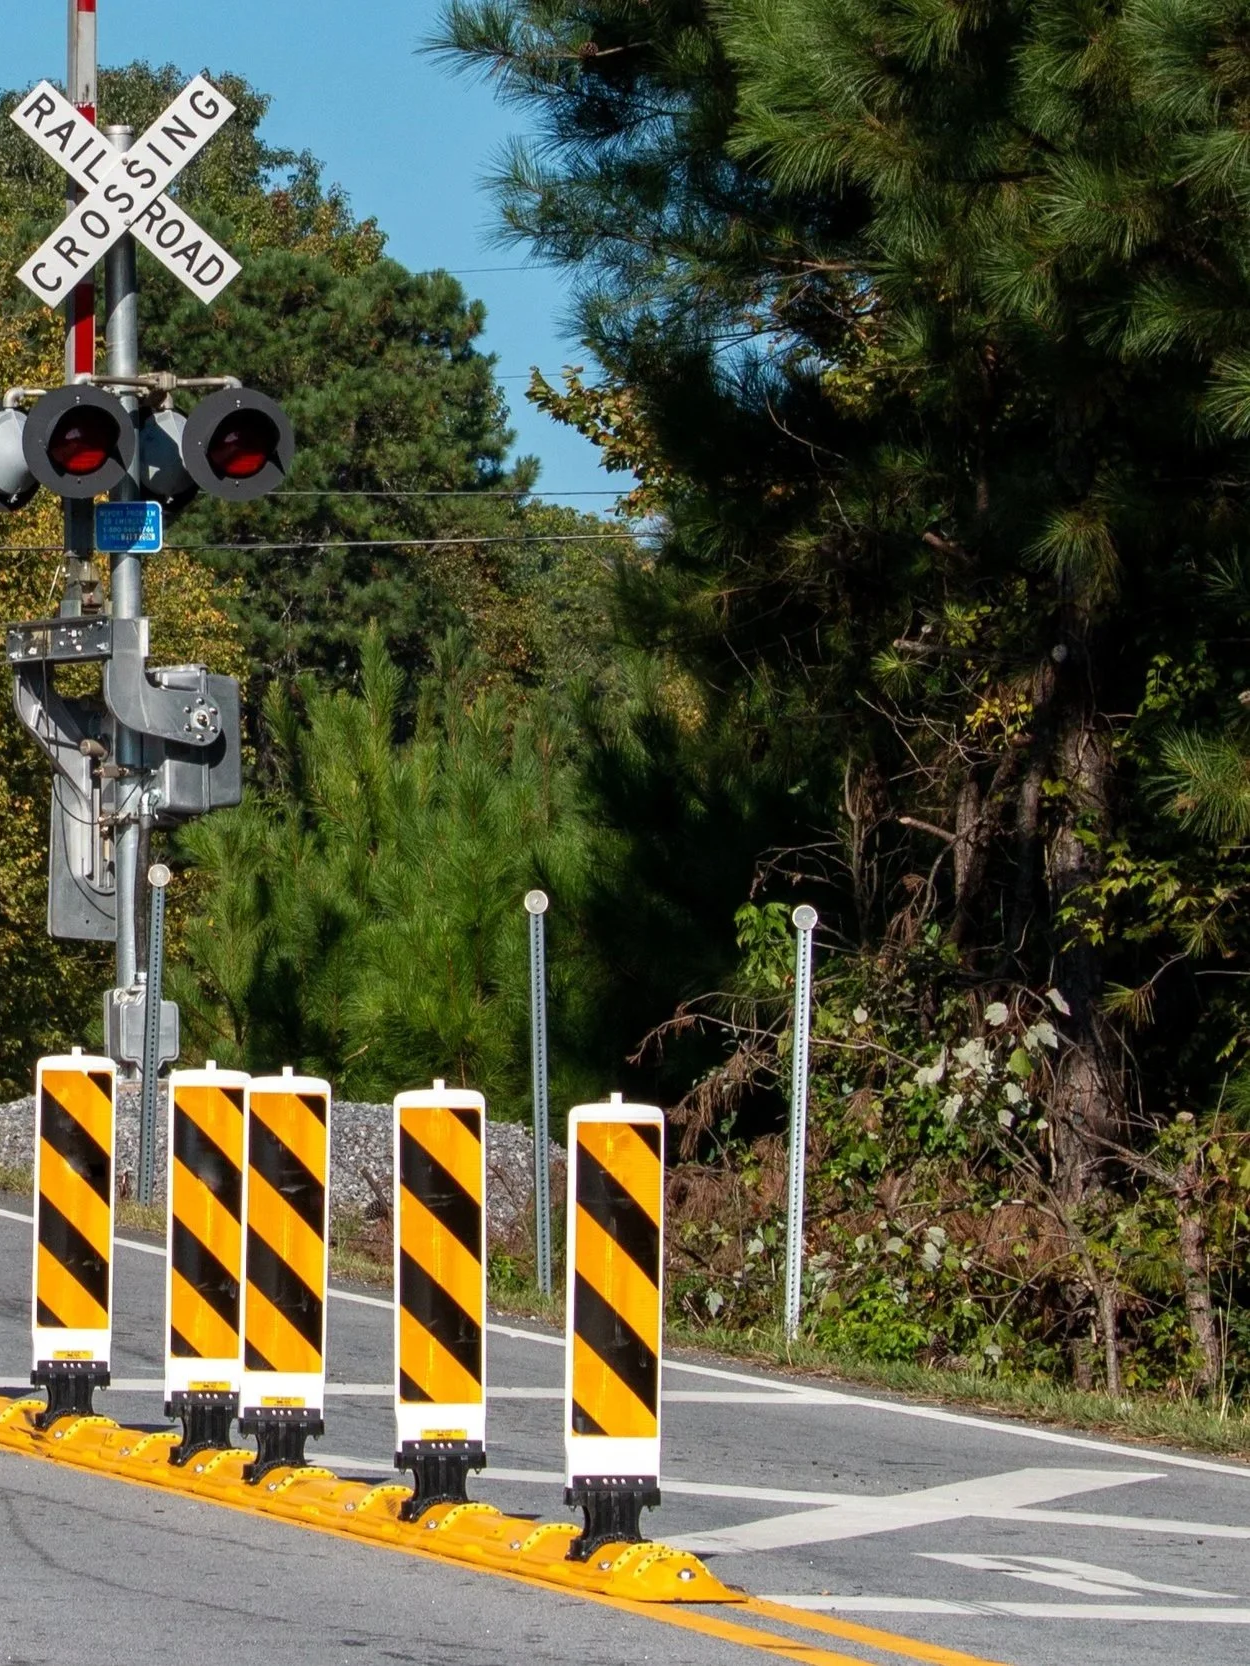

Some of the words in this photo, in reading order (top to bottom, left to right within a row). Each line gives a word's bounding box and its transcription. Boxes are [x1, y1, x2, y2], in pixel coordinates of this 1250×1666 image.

[23, 92, 107, 184] RAIL
[135, 198, 225, 286] ROAD
[32, 90, 220, 292] CROSSING
